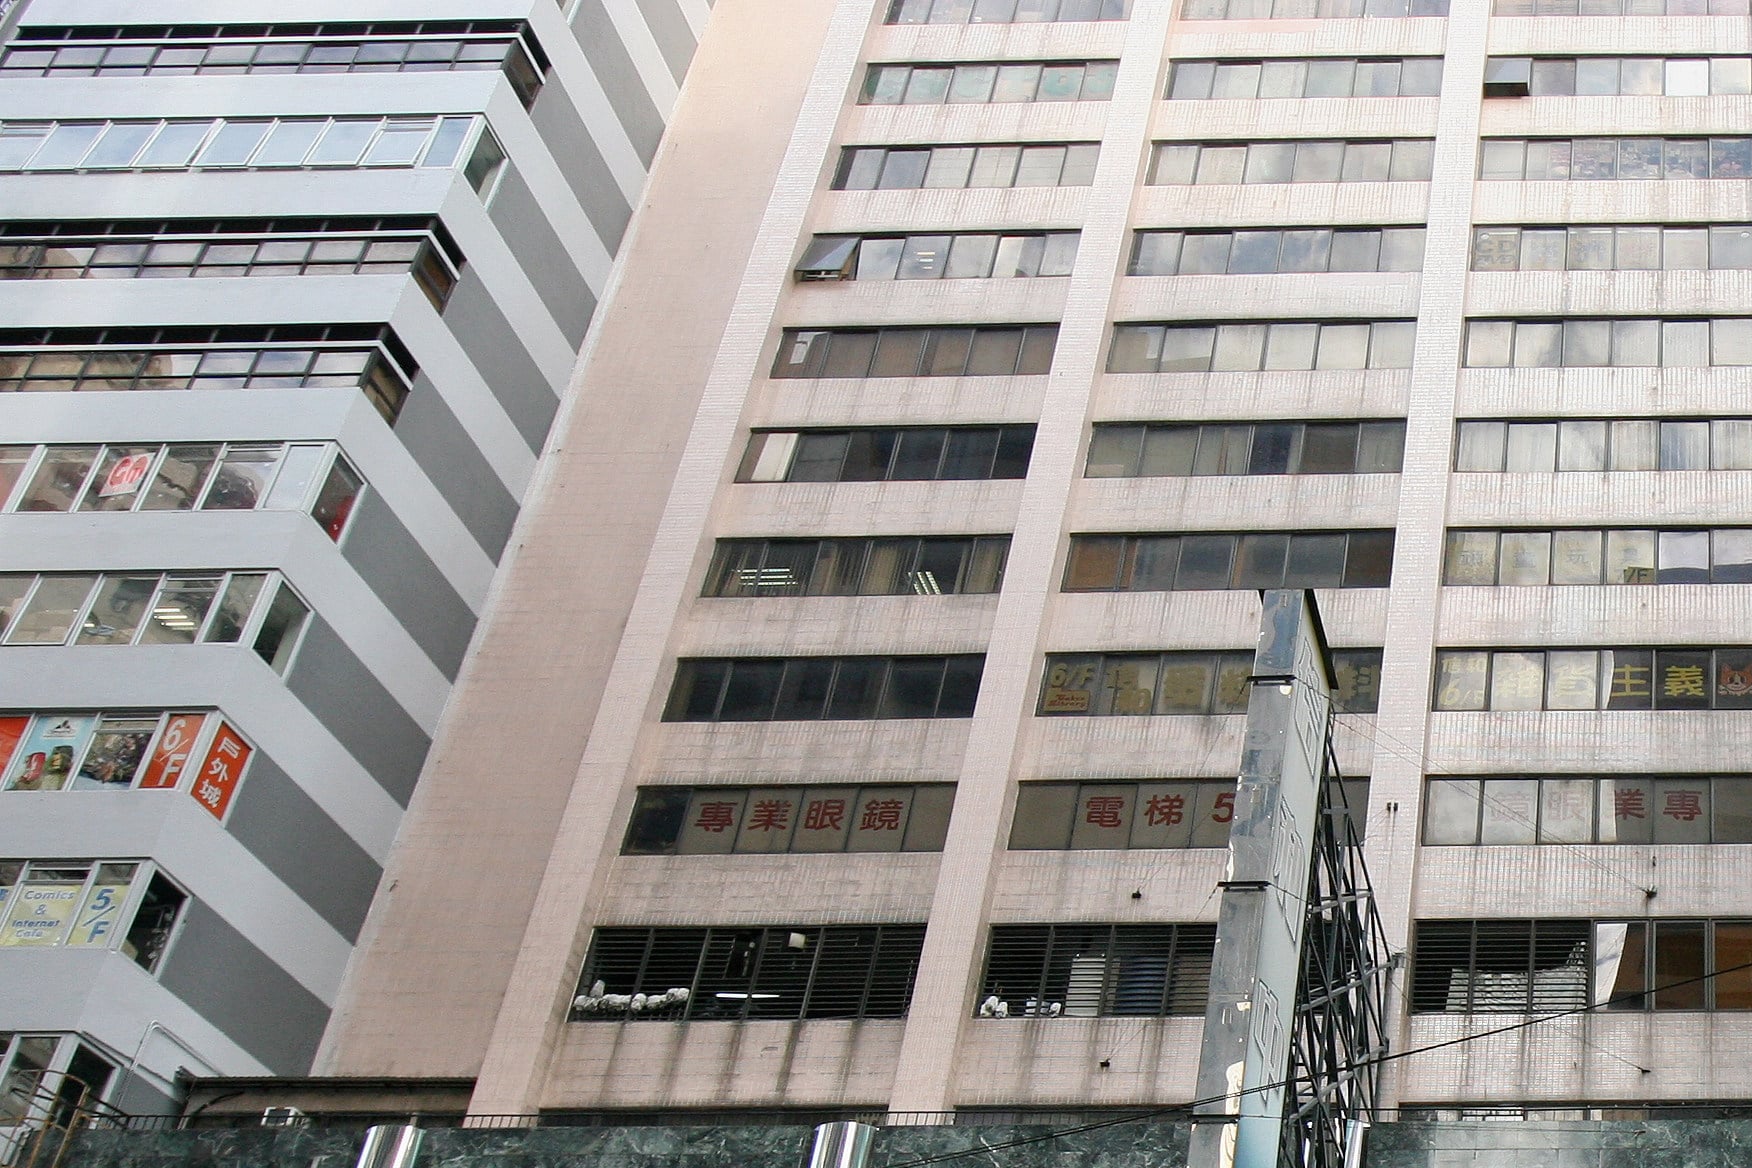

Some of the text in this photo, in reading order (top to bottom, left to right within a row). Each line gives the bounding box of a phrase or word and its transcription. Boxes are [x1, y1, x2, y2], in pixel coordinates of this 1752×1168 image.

[1049, 663, 1095, 688] 6/F
[694, 799, 905, 834] 專業眼鏡
[24, 890, 75, 901] Comics
[34, 904, 46, 916] &
[12, 918, 60, 928] Internet
